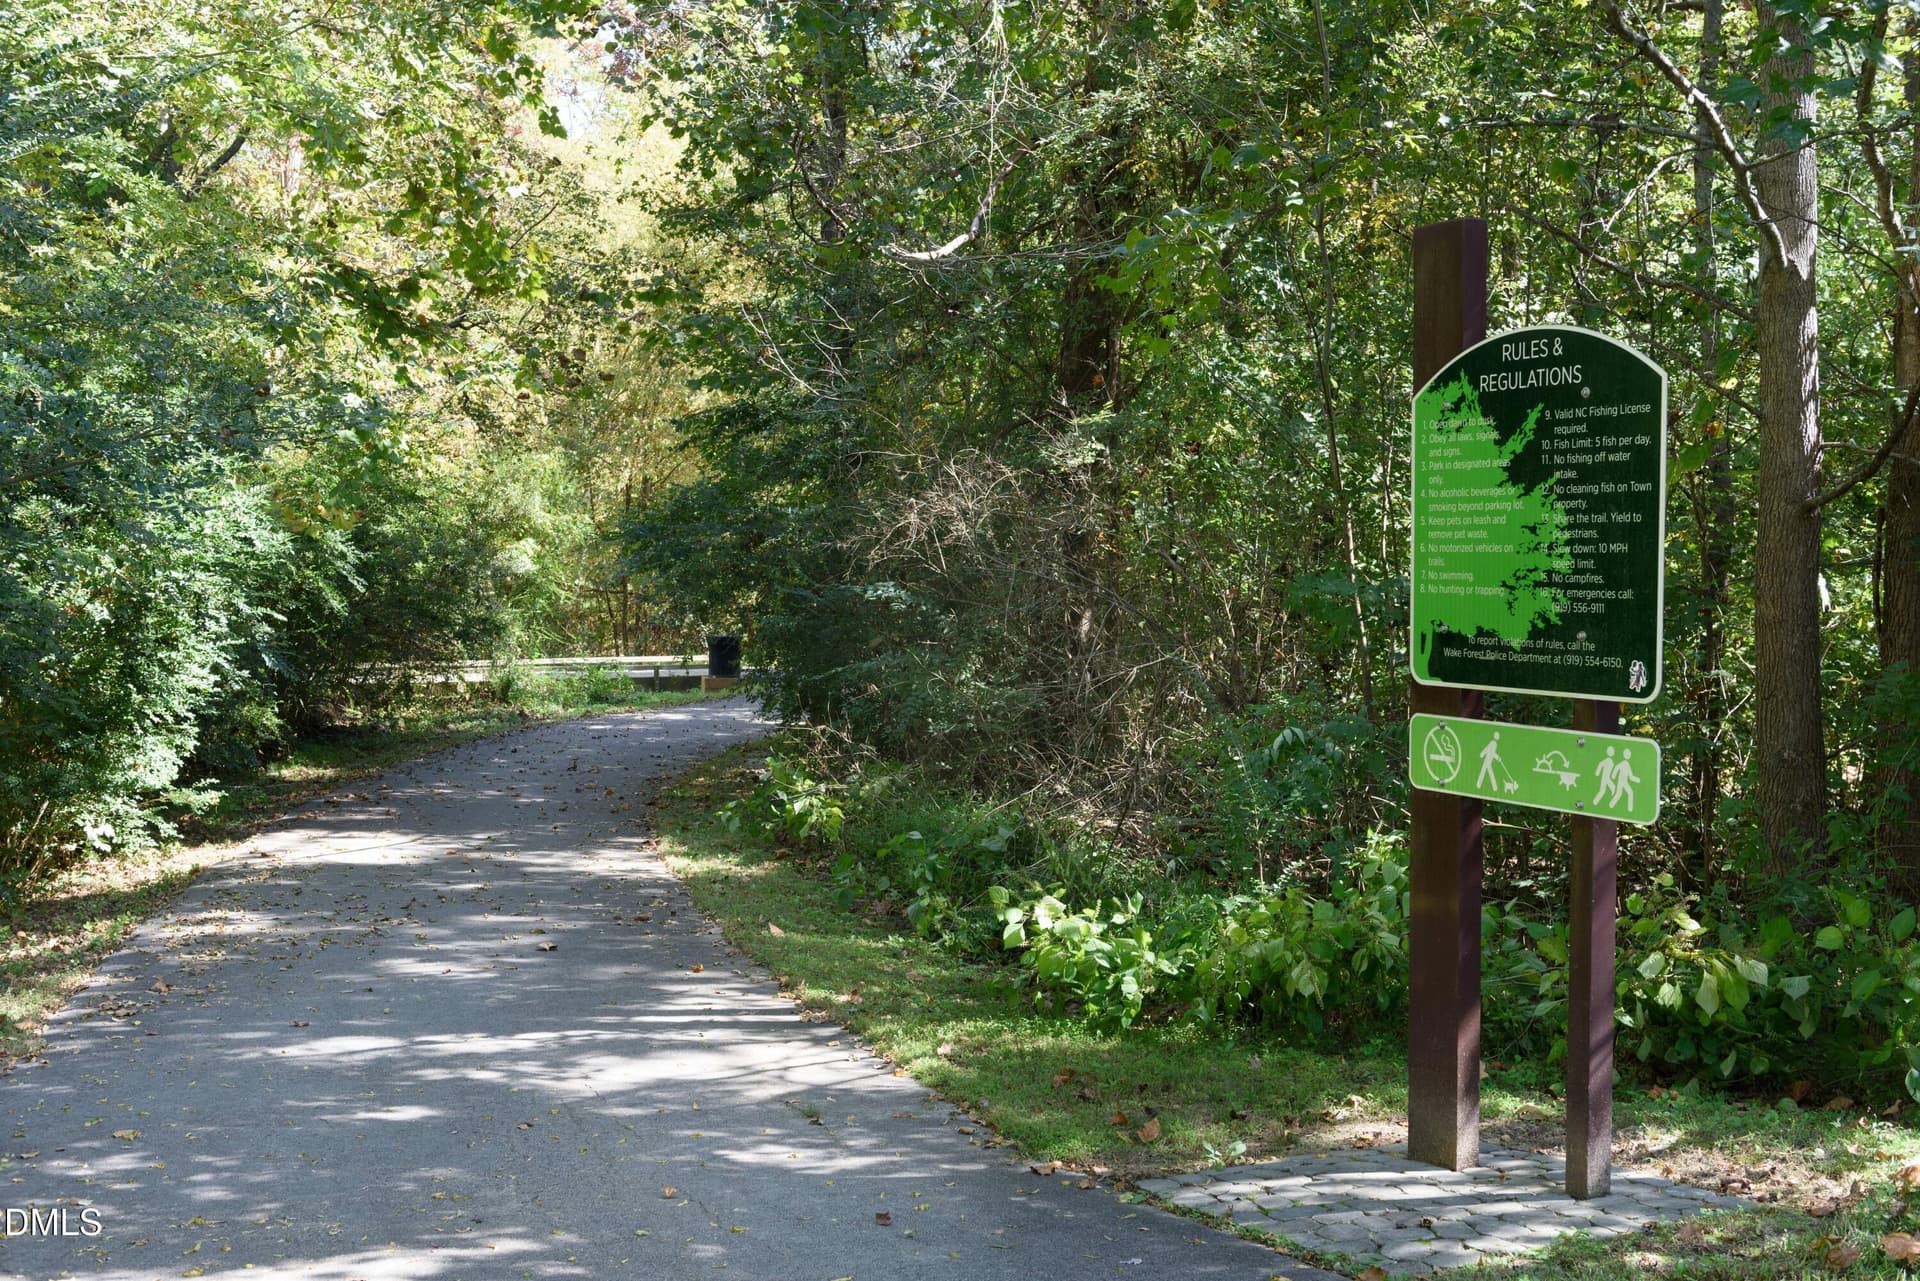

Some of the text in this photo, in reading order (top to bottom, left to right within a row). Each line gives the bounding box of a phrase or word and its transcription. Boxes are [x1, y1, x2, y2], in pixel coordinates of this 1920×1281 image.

[1502, 337, 1563, 362] RULES &
[1480, 365, 1582, 392] REGULATIONS
[1545, 403, 1651, 420] 9. Valid NC Fishing License
[1449, 418, 1467, 428] dawn
[1469, 418, 1476, 427] to
[1554, 423, 1588, 435] required.
[1421, 436, 1427, 444] 2.
[1429, 434, 1446, 444] Obey
[1448, 433, 1456, 442] all
[1541, 434, 1652, 450] 10. Fish Limit: 5 fish per day.
[1429, 448, 1441, 457] and
[1541, 452, 1631, 464] 11. No fishing off water
[1429, 462, 1443, 470] Park
[1445, 461, 1452, 469] in
[1453, 459, 1491, 470] designated
[1554, 470, 1578, 479] intake.
[1429, 489, 1438, 498] No
[1440, 488, 1469, 497] alcoholic
[1470, 487, 1505, 498] beverages
[1507, 487, 1515, 495] or
[1554, 485, 1564, 494] No
[1566, 483, 1599, 494] cleaning
[1601, 482, 1615, 492] fish
[1617, 483, 1628, 491] on
[1630, 481, 1652, 491] Town
[1428, 502, 1456, 512] smoking
[1458, 501, 1483, 512] beyond
[1485, 501, 1511, 511] parking
[1553, 499, 1588, 510] property.
[1428, 517, 1445, 526] Keep
[1447, 517, 1461, 526] pets
[1473, 515, 1491, 524] leash
[1492, 515, 1506, 524] and
[1553, 513, 1574, 524] Share
[1576, 513, 1589, 523] the
[1591, 513, 1608, 523] trail.
[1611, 512, 1631, 523] Yield
[1633, 513, 1642, 522] to
[1454, 530, 1465, 539] pet
[1552, 528, 1599, 538] pedestrians.
[1428, 544, 1438, 552] No
[1439, 544, 1473, 552] motorized
[1475, 544, 1502, 552] vehicles
[1504, 544, 1513, 552] on
[1552, 543, 1571, 554] Slow
[1572, 543, 1597, 554] down:
[1598, 543, 1607, 554] 10
[1609, 543, 1628, 553] MPH
[1552, 559, 1596, 570] speed limit.
[1428, 571, 1438, 579] No
[1552, 573, 1563, 582] No
[1565, 573, 1604, 584] campfires.
[1428, 585, 1438, 593] No
[1439, 585, 1464, 595] hunting
[1552, 587, 1565, 597] For
[1566, 589, 1616, 600] emergencies
[1618, 589, 1634, 599] call:
[1552, 602, 1605, 614] (919) 556-9111
[1468, 635, 1596, 651] To report violations of rules, call the
[1443, 648, 1623, 668] Wake Forest Police Department at (919) 554-6150.
